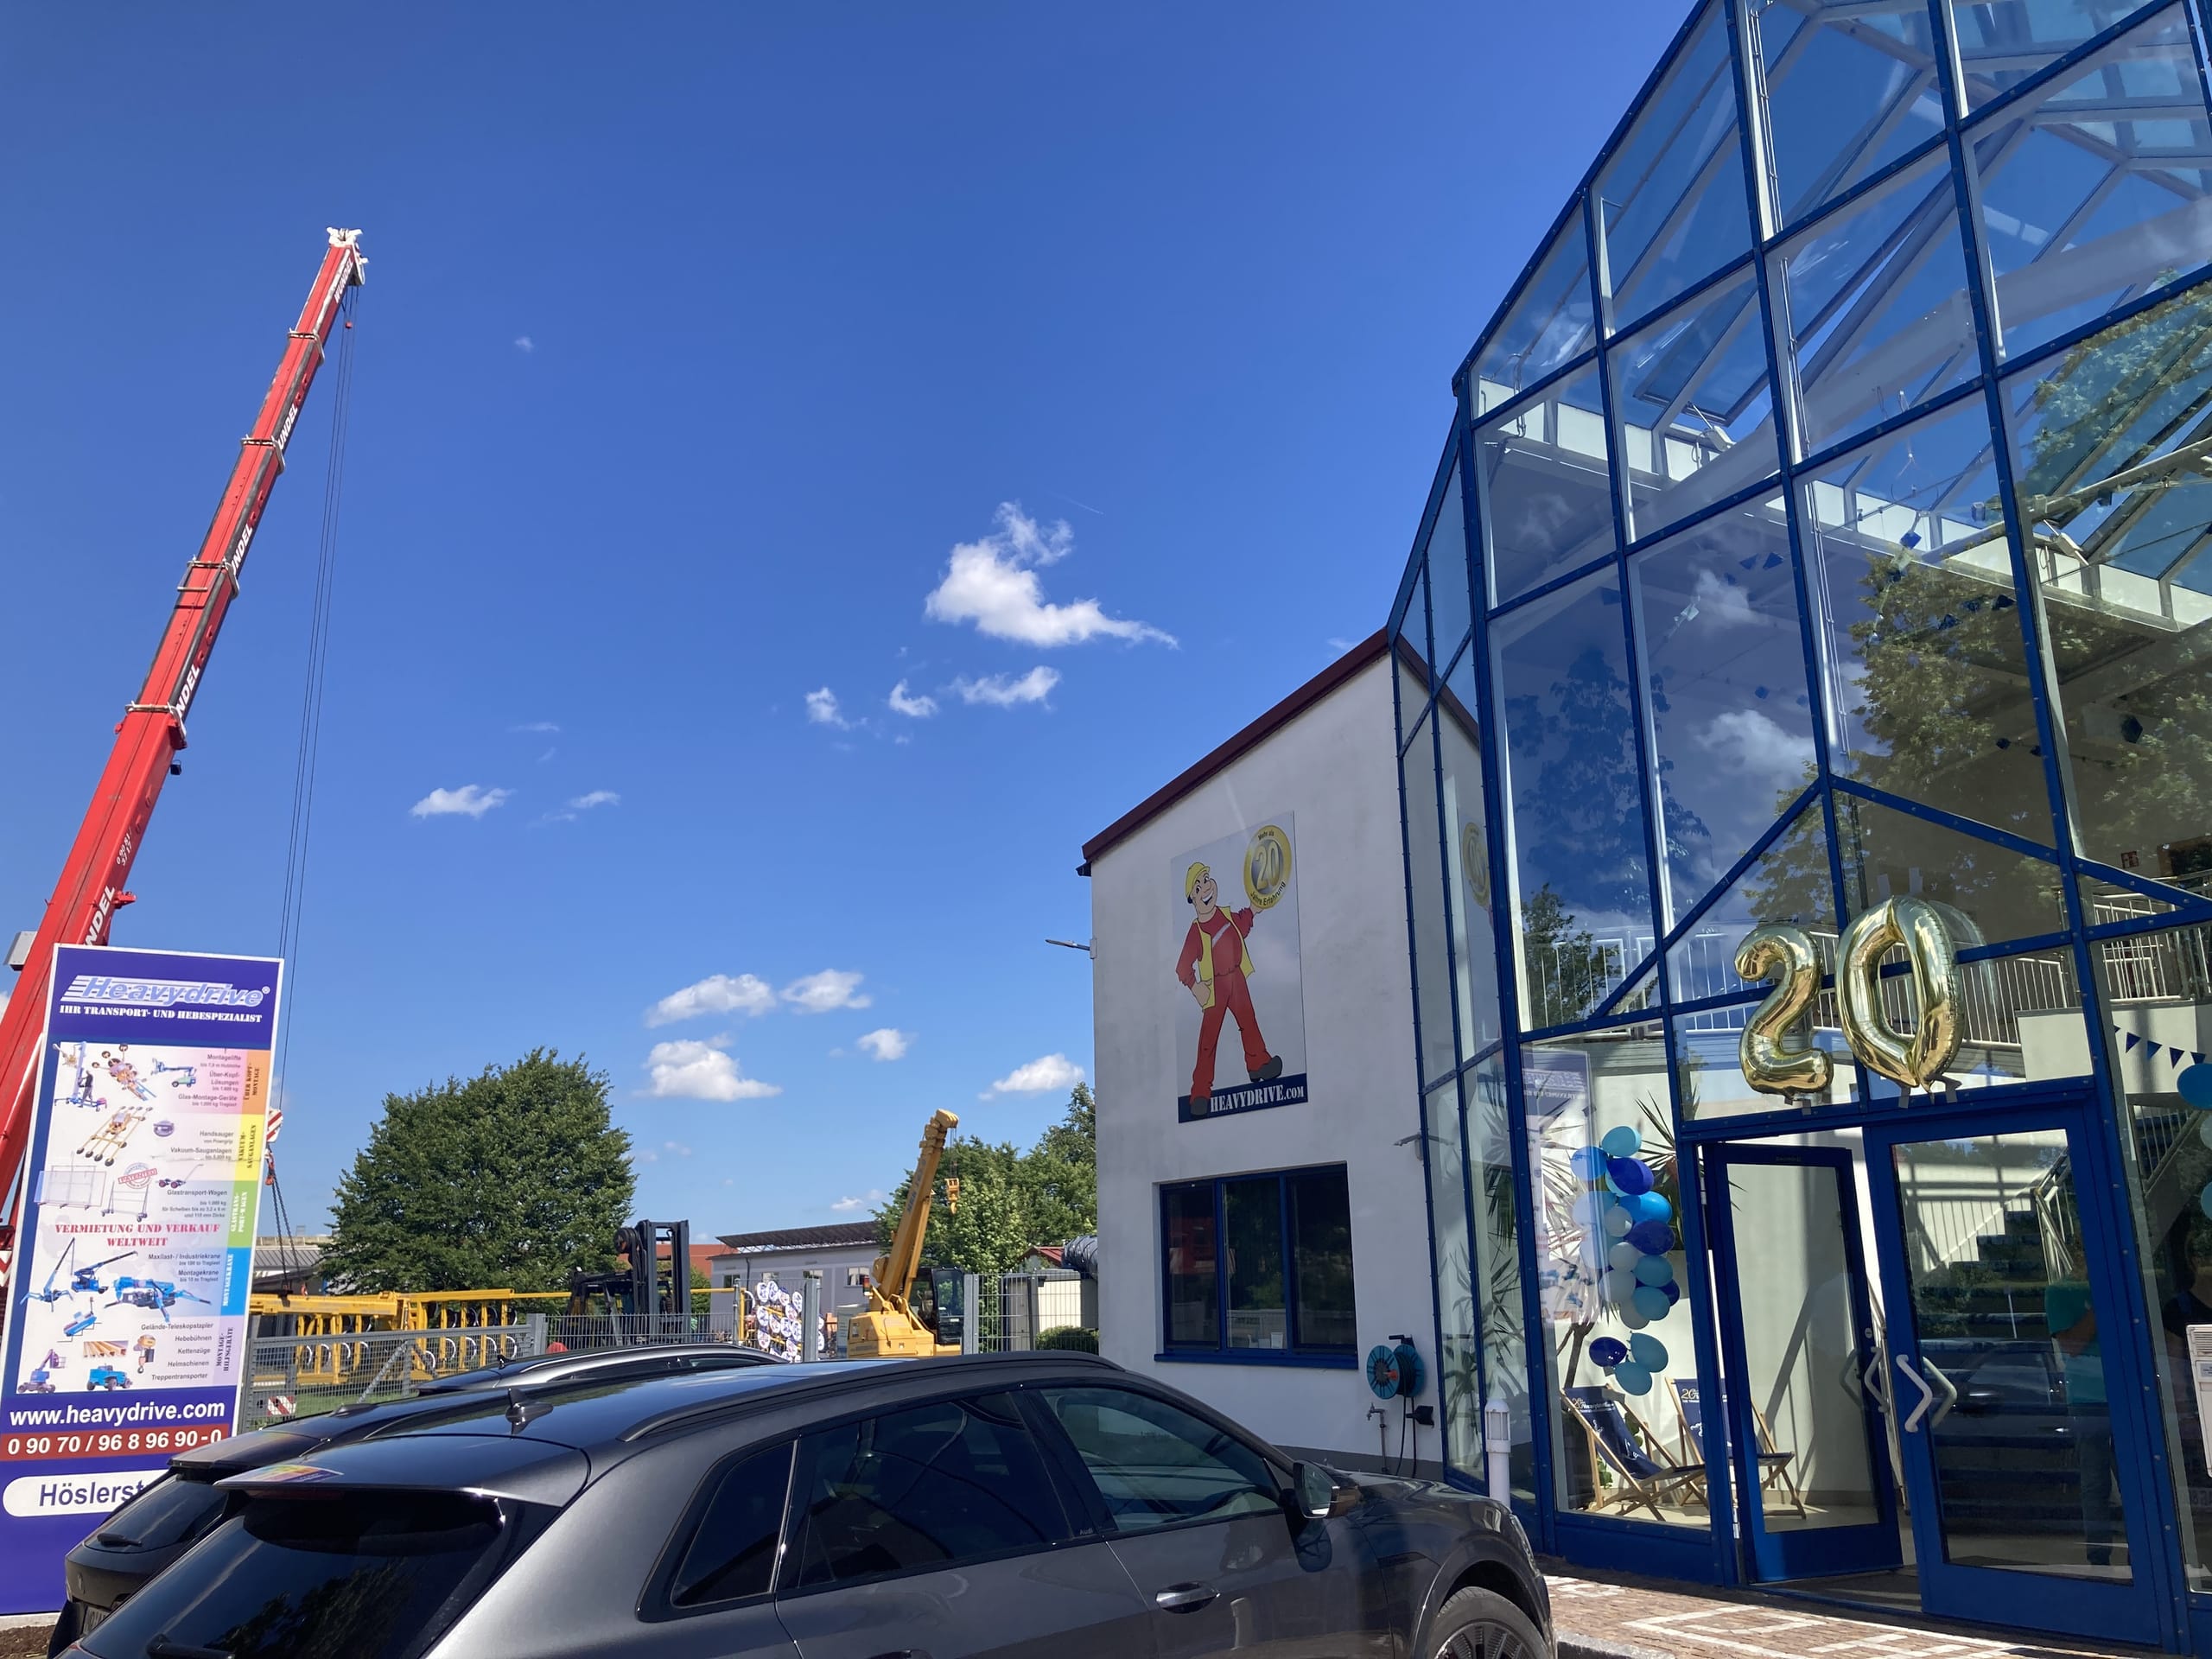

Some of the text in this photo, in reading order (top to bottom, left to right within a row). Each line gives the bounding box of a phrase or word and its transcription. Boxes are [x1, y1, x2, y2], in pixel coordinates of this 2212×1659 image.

[277, 403, 298, 450] UNDEL
[231, 523, 253, 576] NDEL
[175, 663, 200, 720] NDEL
[1253, 840, 1281, 891] 20
[84, 885, 116, 946] NDEL
[1733, 895, 1966, 1095] 20
[59, 1004, 263, 1023] IHR TRANSPORT- UND HEBESPEZIALIST
[200, 1129, 234, 1138] Handsauger
[54, 1223, 221, 1233] VERMIETUNG UND VERKAUF
[106, 1236, 168, 1247] WELTWEIT
[151, 1373, 208, 1382] Treppentransporter
[9, 1401, 226, 1427] www.heavydrive.com
[7, 1437, 21, 1455] 0
[25, 1436, 51, 1454] 90
[56, 1435, 81, 1452] 70
[97, 1433, 123, 1452] 96
[127, 1433, 141, 1450] 8
[144, 1431, 169, 1449] 96
[38, 1479, 145, 1507] Höslerst
